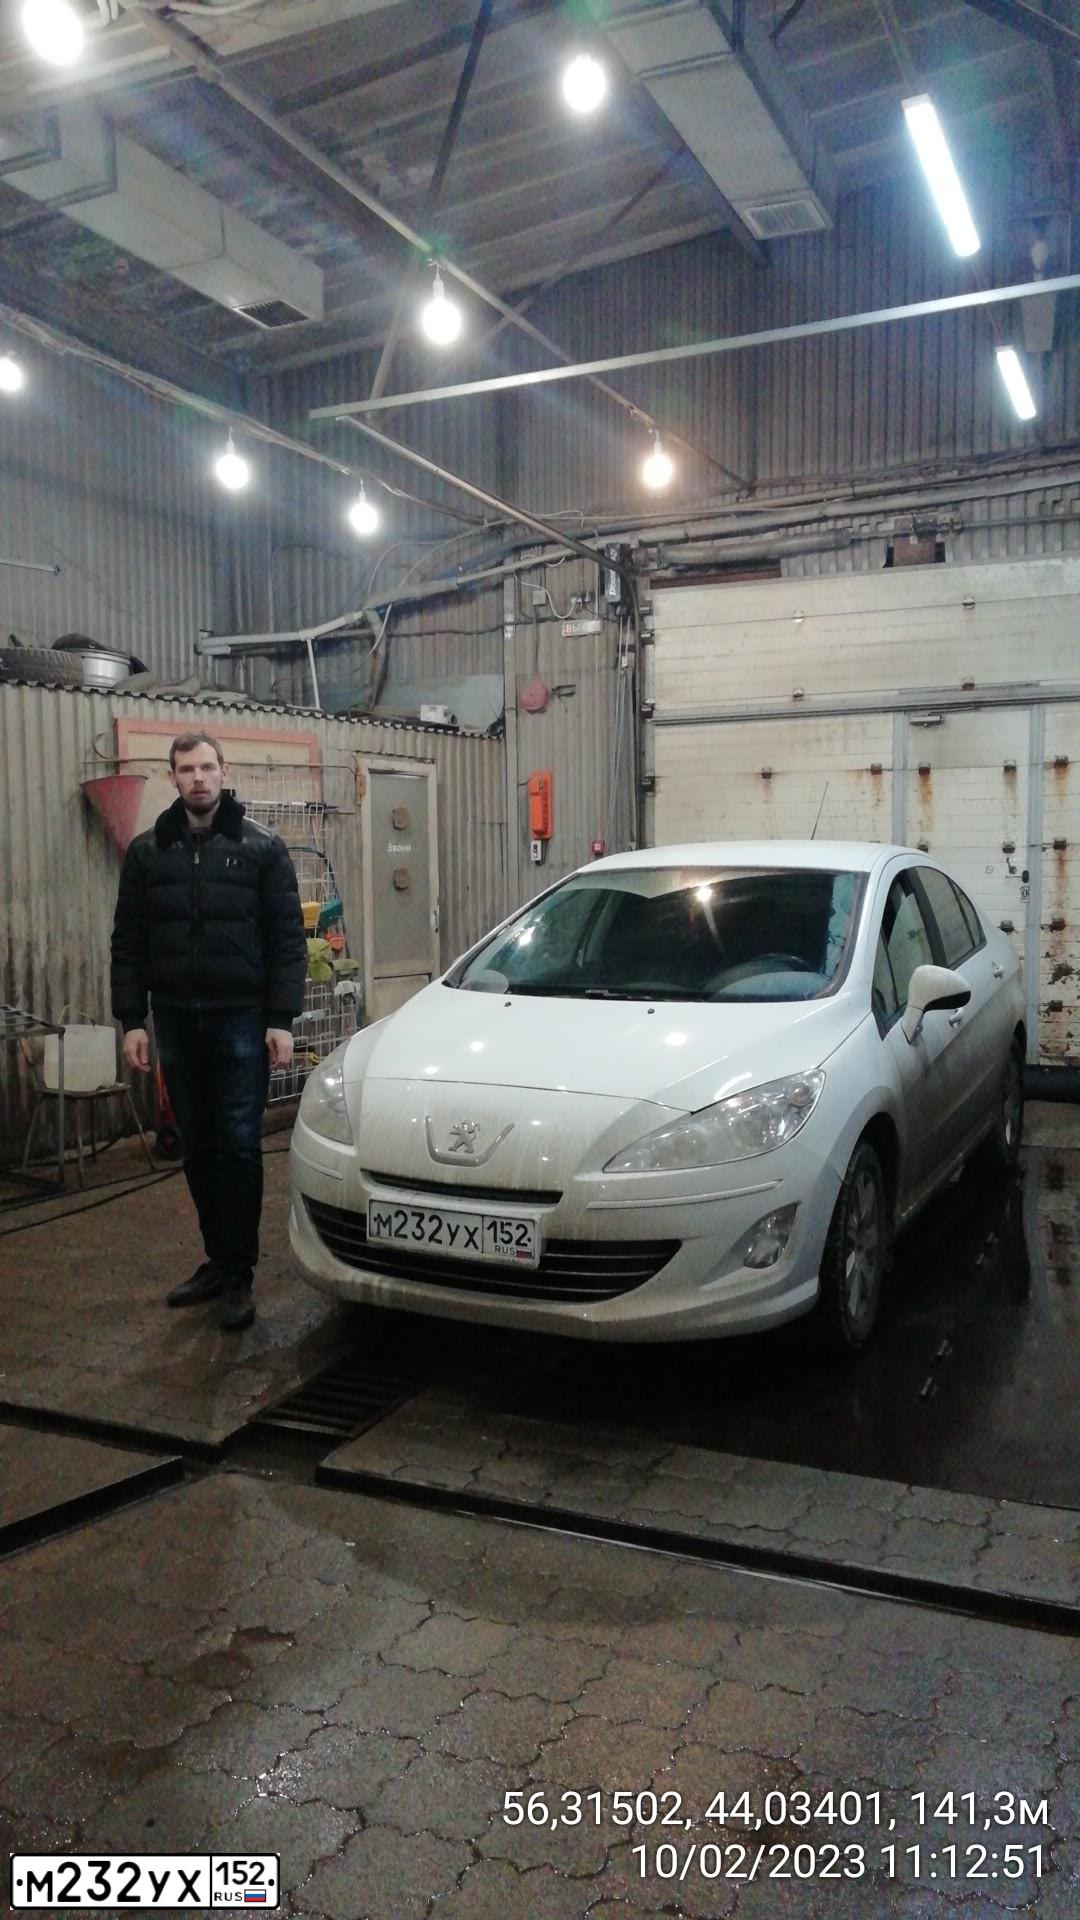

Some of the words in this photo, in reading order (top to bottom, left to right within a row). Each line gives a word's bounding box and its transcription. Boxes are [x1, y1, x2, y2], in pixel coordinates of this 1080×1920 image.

[375, 1210, 479, 1250] М232УХ
[487, 1221, 528, 1247] 152
[495, 1245, 515, 1256] RUS
